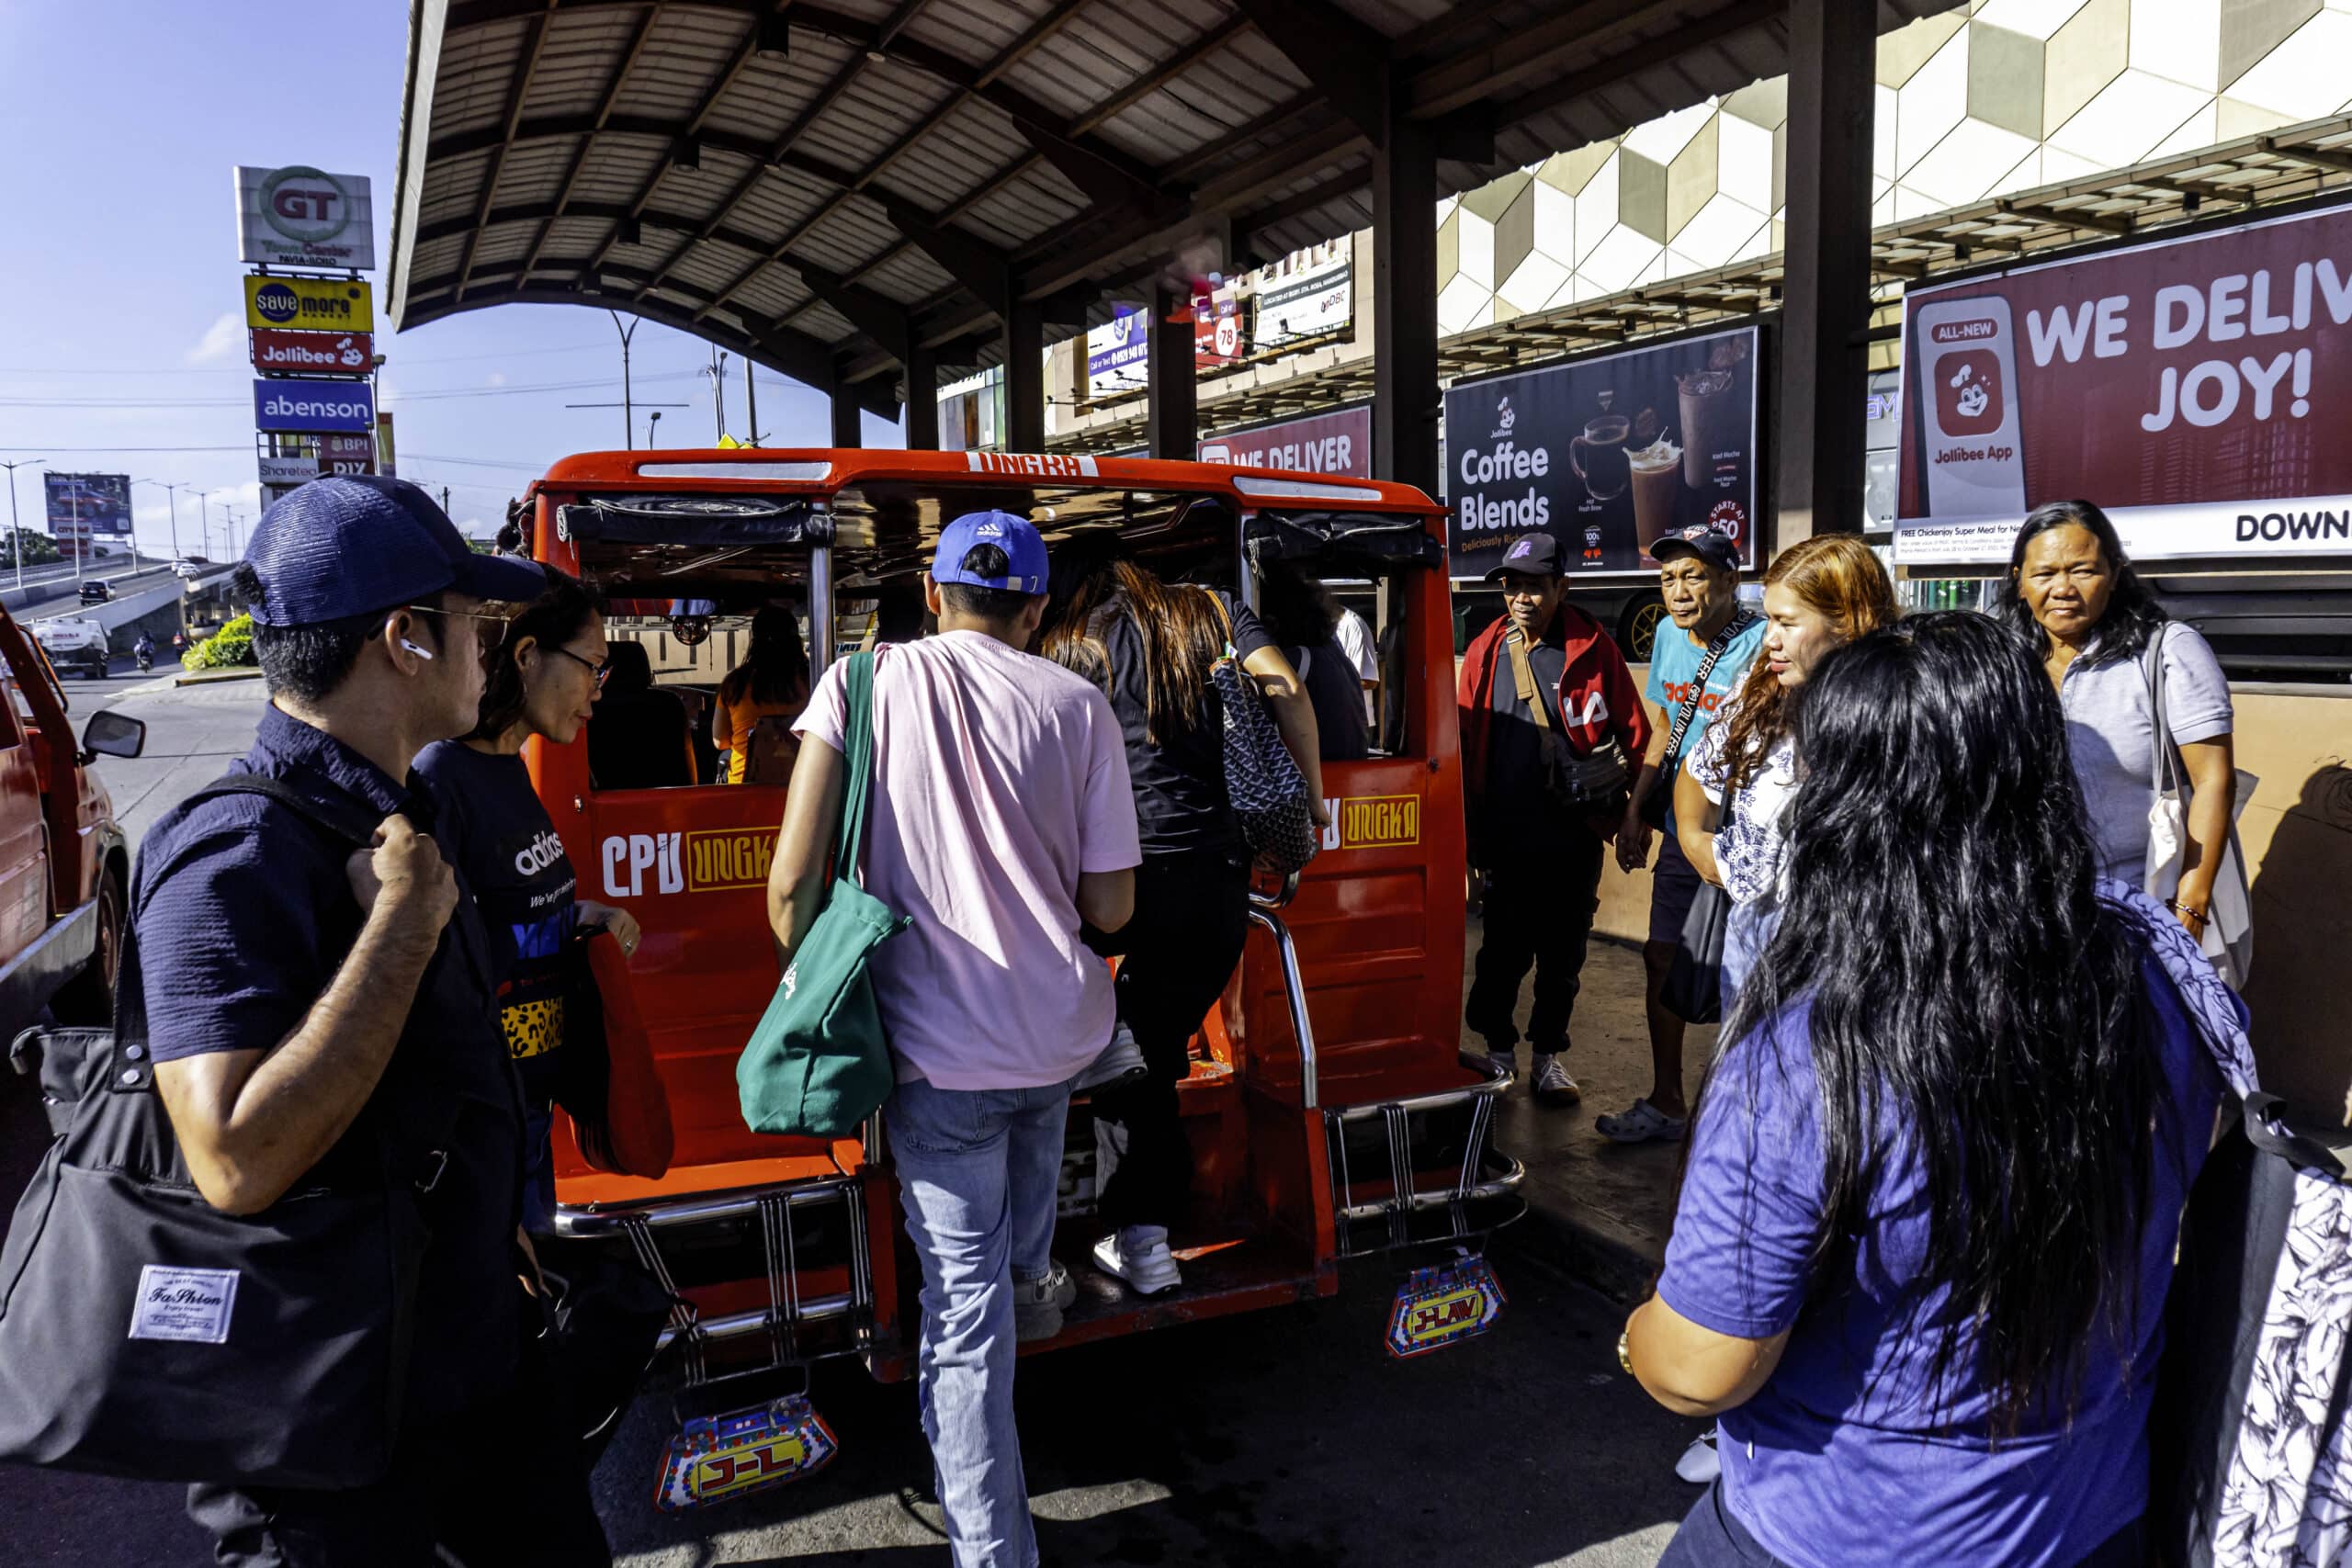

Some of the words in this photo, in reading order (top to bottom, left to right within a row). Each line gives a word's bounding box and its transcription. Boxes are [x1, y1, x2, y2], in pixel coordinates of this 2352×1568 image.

[275, 189, 337, 220] GT
[302, 243, 354, 257] Center
[256, 295, 297, 310] save
[301, 297, 351, 313] more
[1938, 322, 1992, 340] ALL-NEW
[2026, 295, 2130, 367] WE
[263, 345, 336, 365] Jollibee
[2140, 348, 2312, 433] JOY!
[264, 396, 369, 418] abenson
[344, 437, 368, 451] BPI
[1269, 434, 1352, 473] DELIVER
[1935, 446, 1984, 466] Jollibee
[1987, 445, 2013, 463] App
[260, 465, 317, 477] Sharetea
[978, 451, 1082, 477] UNGKA
[1461, 441, 1549, 485] Coffee
[1461, 486, 1549, 531] Blends
[1711, 500, 1736, 520] STARTS
[977, 529, 1002, 537] adidas
[1901, 529, 1917, 537] FREE
[1917, 526, 1952, 538] Chickenjoy
[1955, 526, 1975, 536] Super
[1977, 526, 1996, 535] Meal
[1997, 525, 2008, 534] for
[2236, 509, 2349, 542] DOWN
[1462, 535, 1502, 553] Deliciously
[1666, 699, 1696, 759] VOLUNTEER
[1347, 801, 1416, 842] UNGKA
[602, 831, 684, 897] CPU
[692, 834, 781, 884] UNGK
[1413, 1296, 1477, 1334] J-LAW
